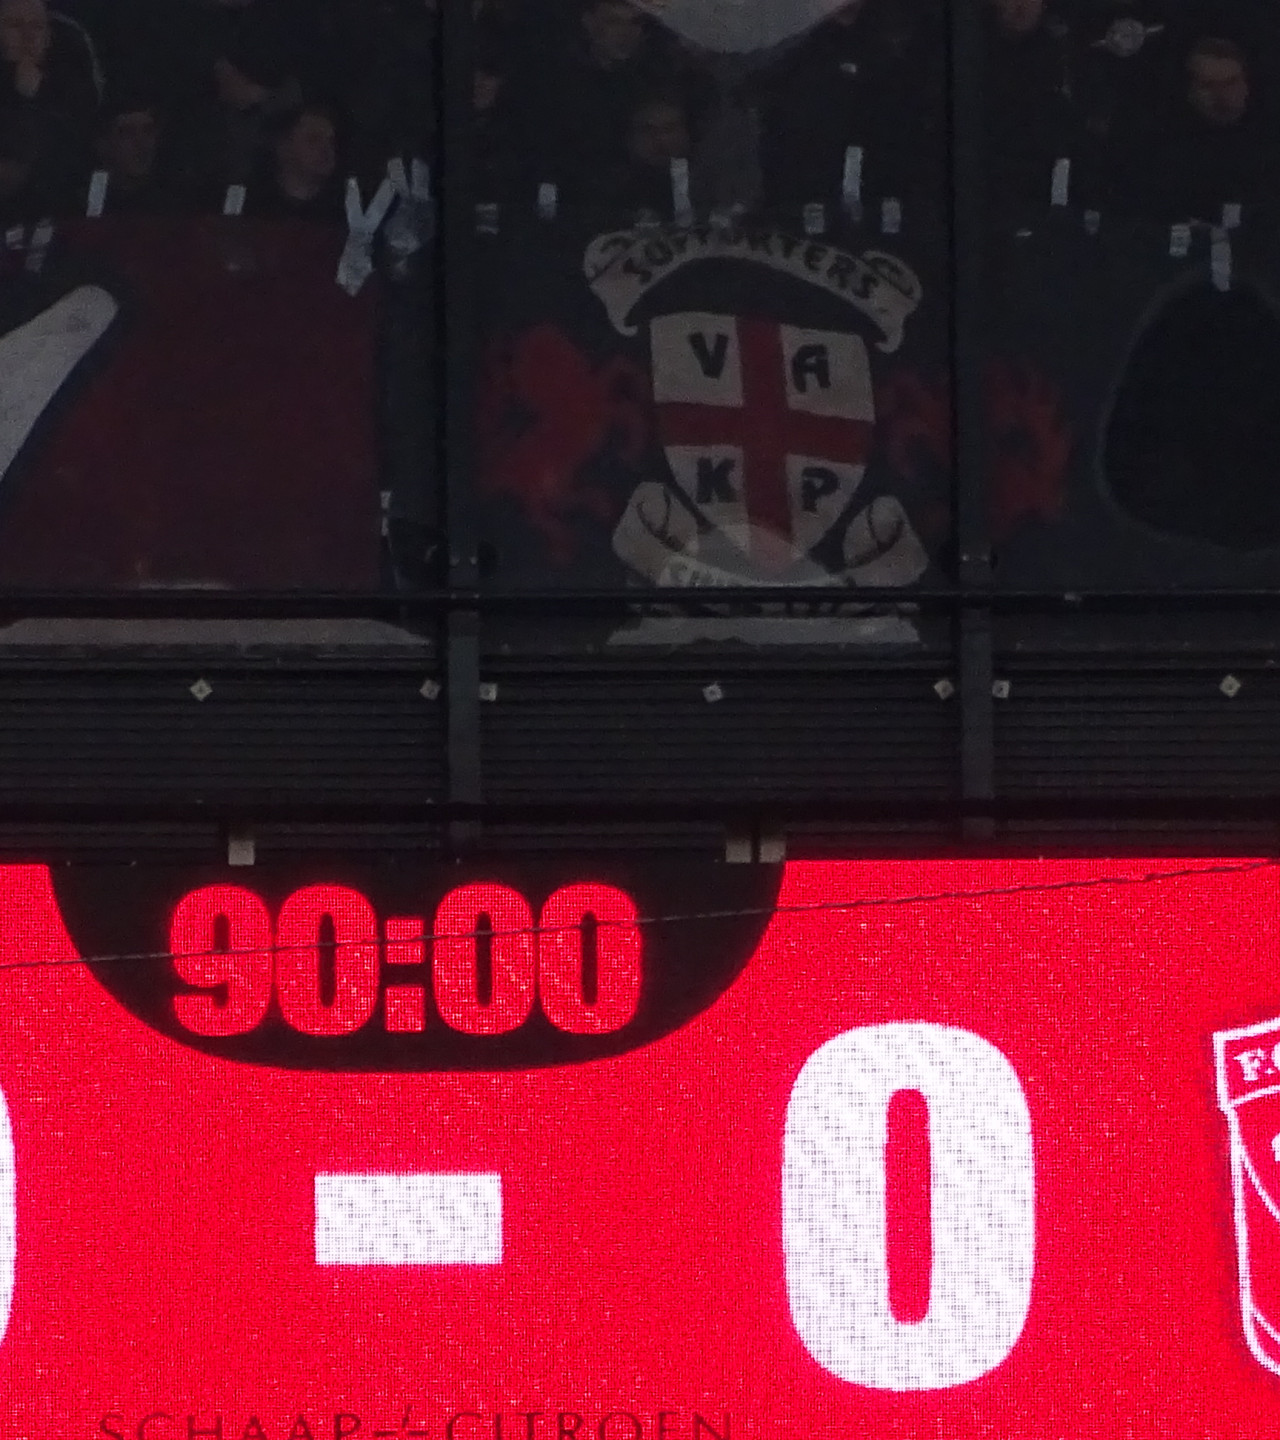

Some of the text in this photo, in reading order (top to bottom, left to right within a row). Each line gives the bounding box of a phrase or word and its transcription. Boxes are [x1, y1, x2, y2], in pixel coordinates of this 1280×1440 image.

[688, 332, 729, 378] V
[696, 457, 840, 513] K P
[170, 882, 643, 1036] 90:00
[782, 1020, 1036, 1392] 0
